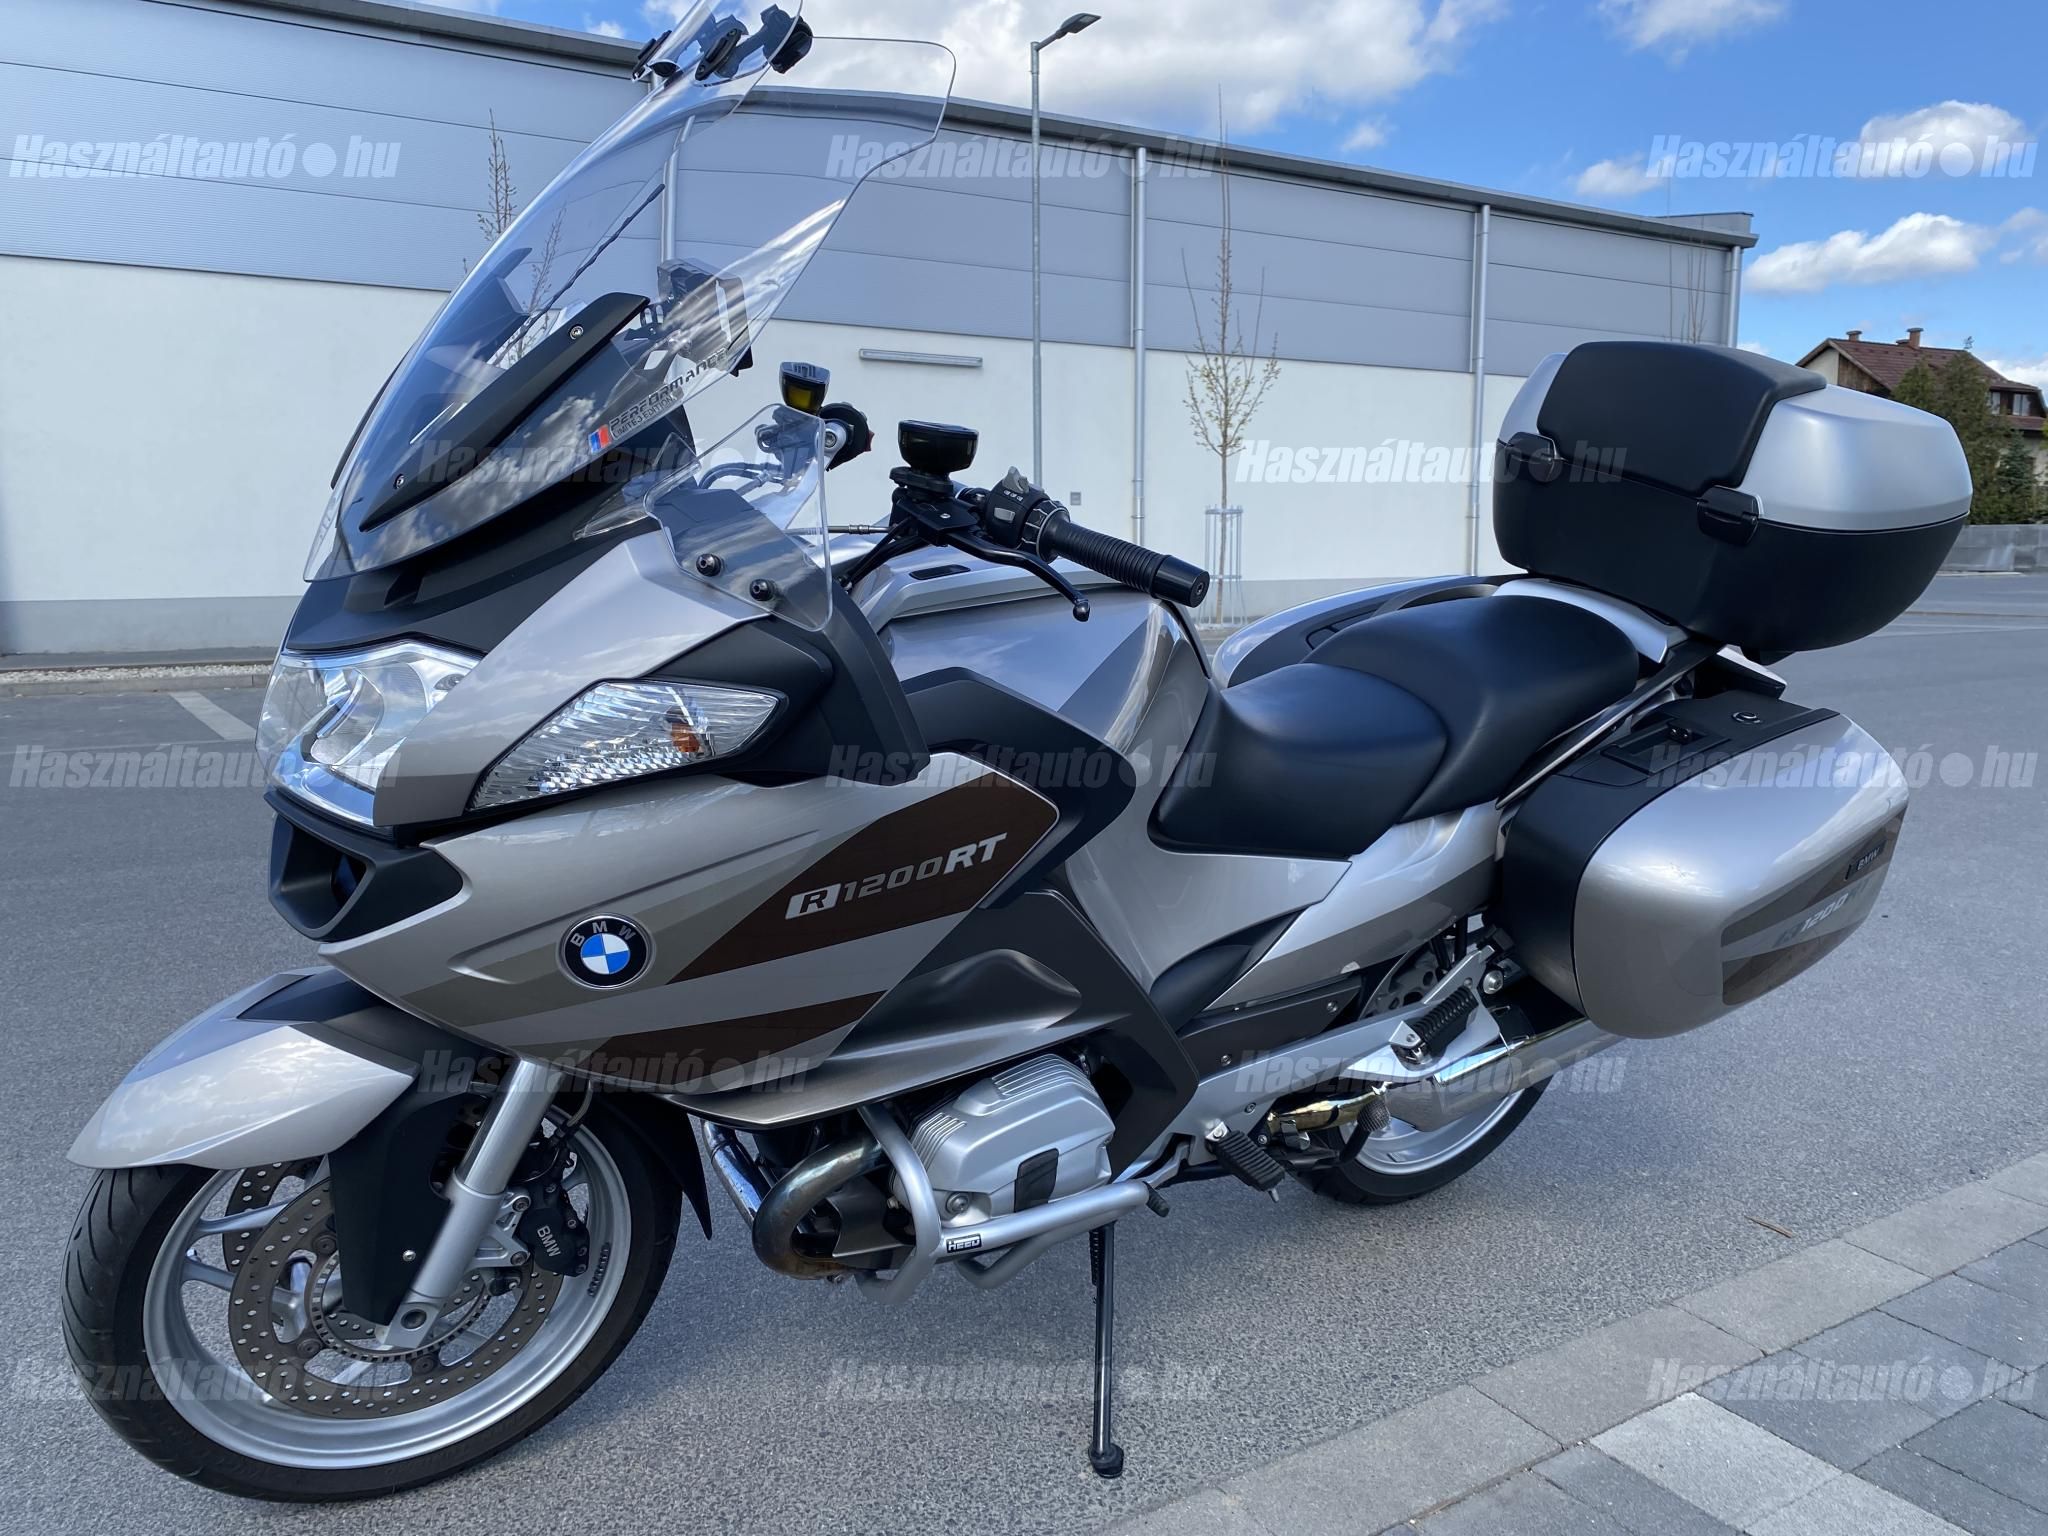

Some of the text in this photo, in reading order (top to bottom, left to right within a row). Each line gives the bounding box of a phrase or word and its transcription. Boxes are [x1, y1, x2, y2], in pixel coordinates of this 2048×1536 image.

[609, 348, 728, 429] PERFORMANCE
[785, 832, 1008, 920] R1200RT
[1856, 847, 1880, 871] BMW
[569, 919, 636, 948] BMW
[536, 1224, 562, 1258] BMW
